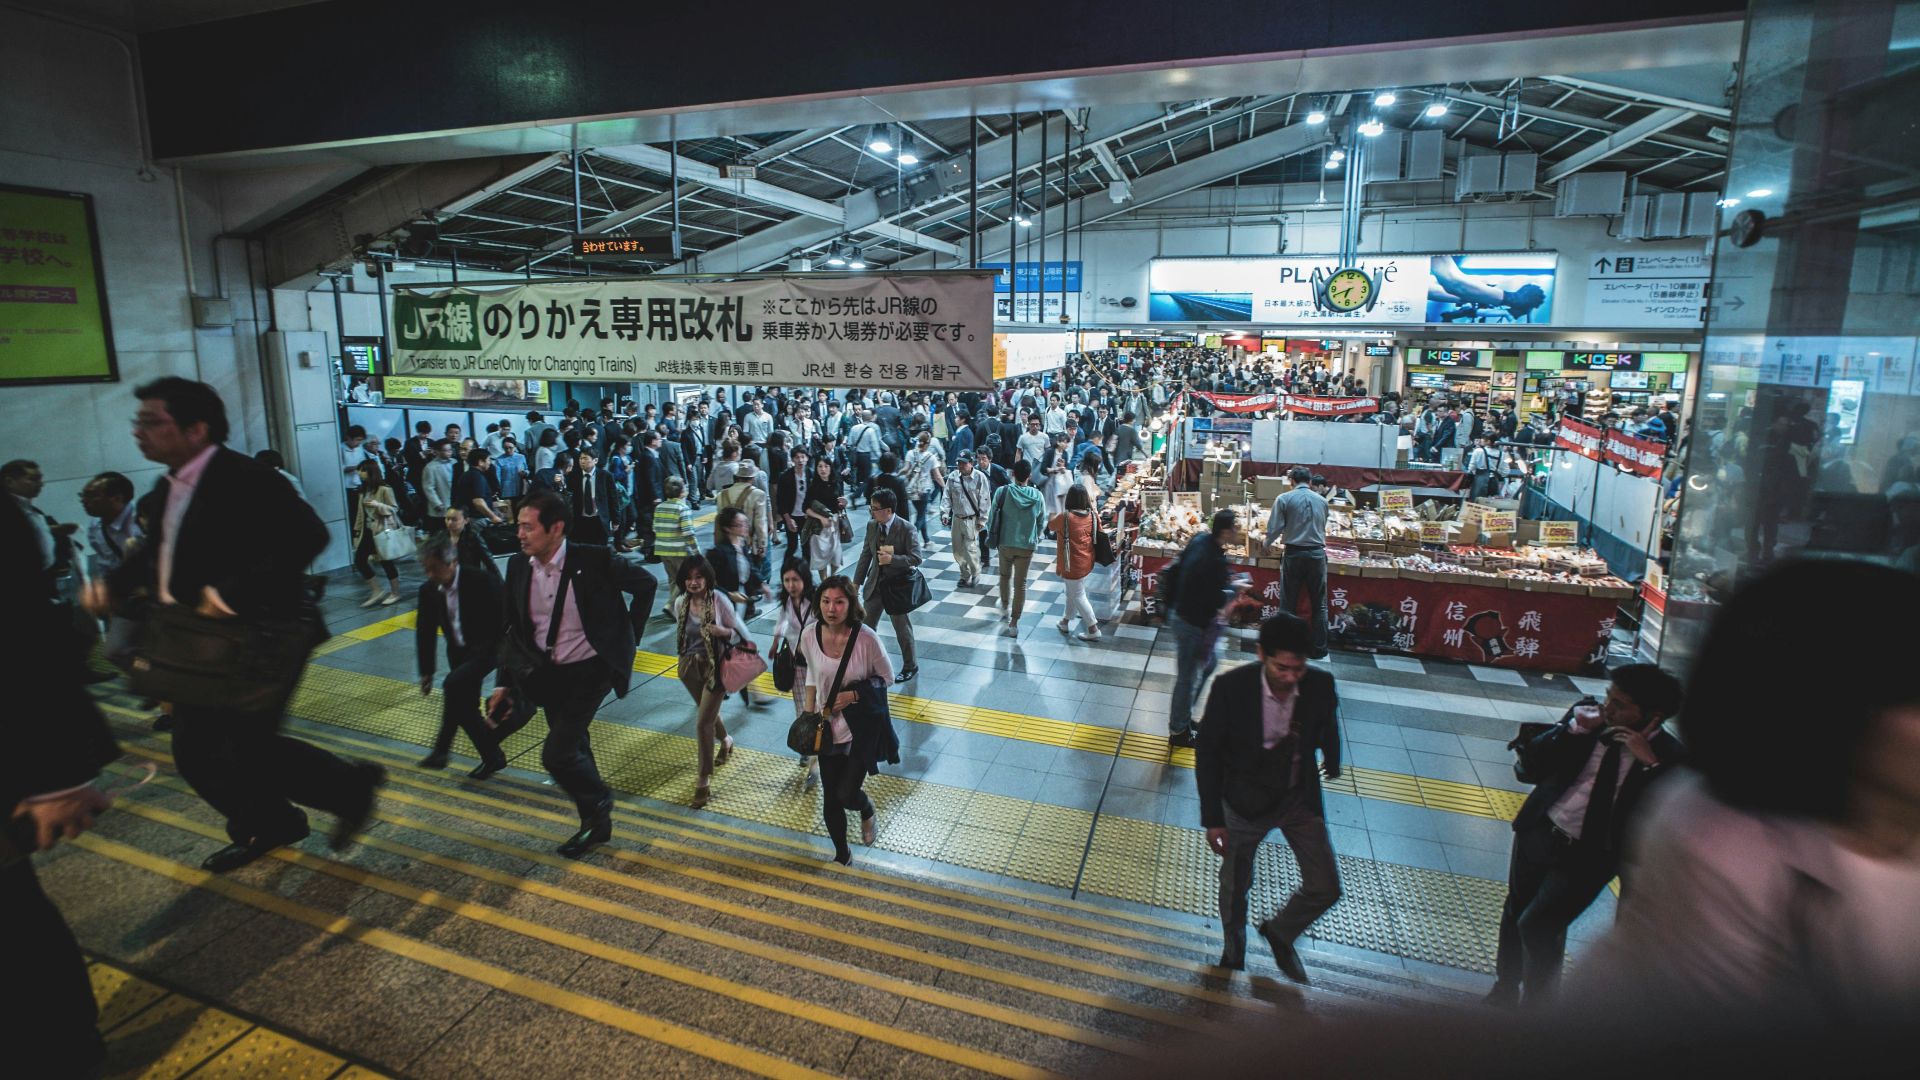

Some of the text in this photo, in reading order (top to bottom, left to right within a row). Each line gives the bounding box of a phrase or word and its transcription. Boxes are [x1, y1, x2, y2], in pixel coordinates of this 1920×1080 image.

[1346, 272, 1354, 280] 12
[762, 321, 975, 342] 乗車券か入場券が必要です。
[373, 346, 380, 361] 1
[1427, 350, 1471, 361] KIOSK
[1573, 353, 1632, 365] KIOSK
[409, 355, 447, 370] Transfer
[449, 356, 461, 370] to
[463, 356, 476, 369] JR
[528, 355, 542, 370] for
[544, 356, 595, 374] Changing
[598, 356, 637, 373] Trains)
[654, 360, 774, 377] JR线换乘专用剪票口
[843, 361, 873, 379] 환승
[878, 363, 909, 380] 전용
[915, 364, 962, 382] 개찰구
[1328, 587, 1350, 634] 高山
[1392, 596, 1418, 649] 白川郷
[1443, 602, 1468, 649] 信州
[1516, 610, 1543, 659] 飛騨
